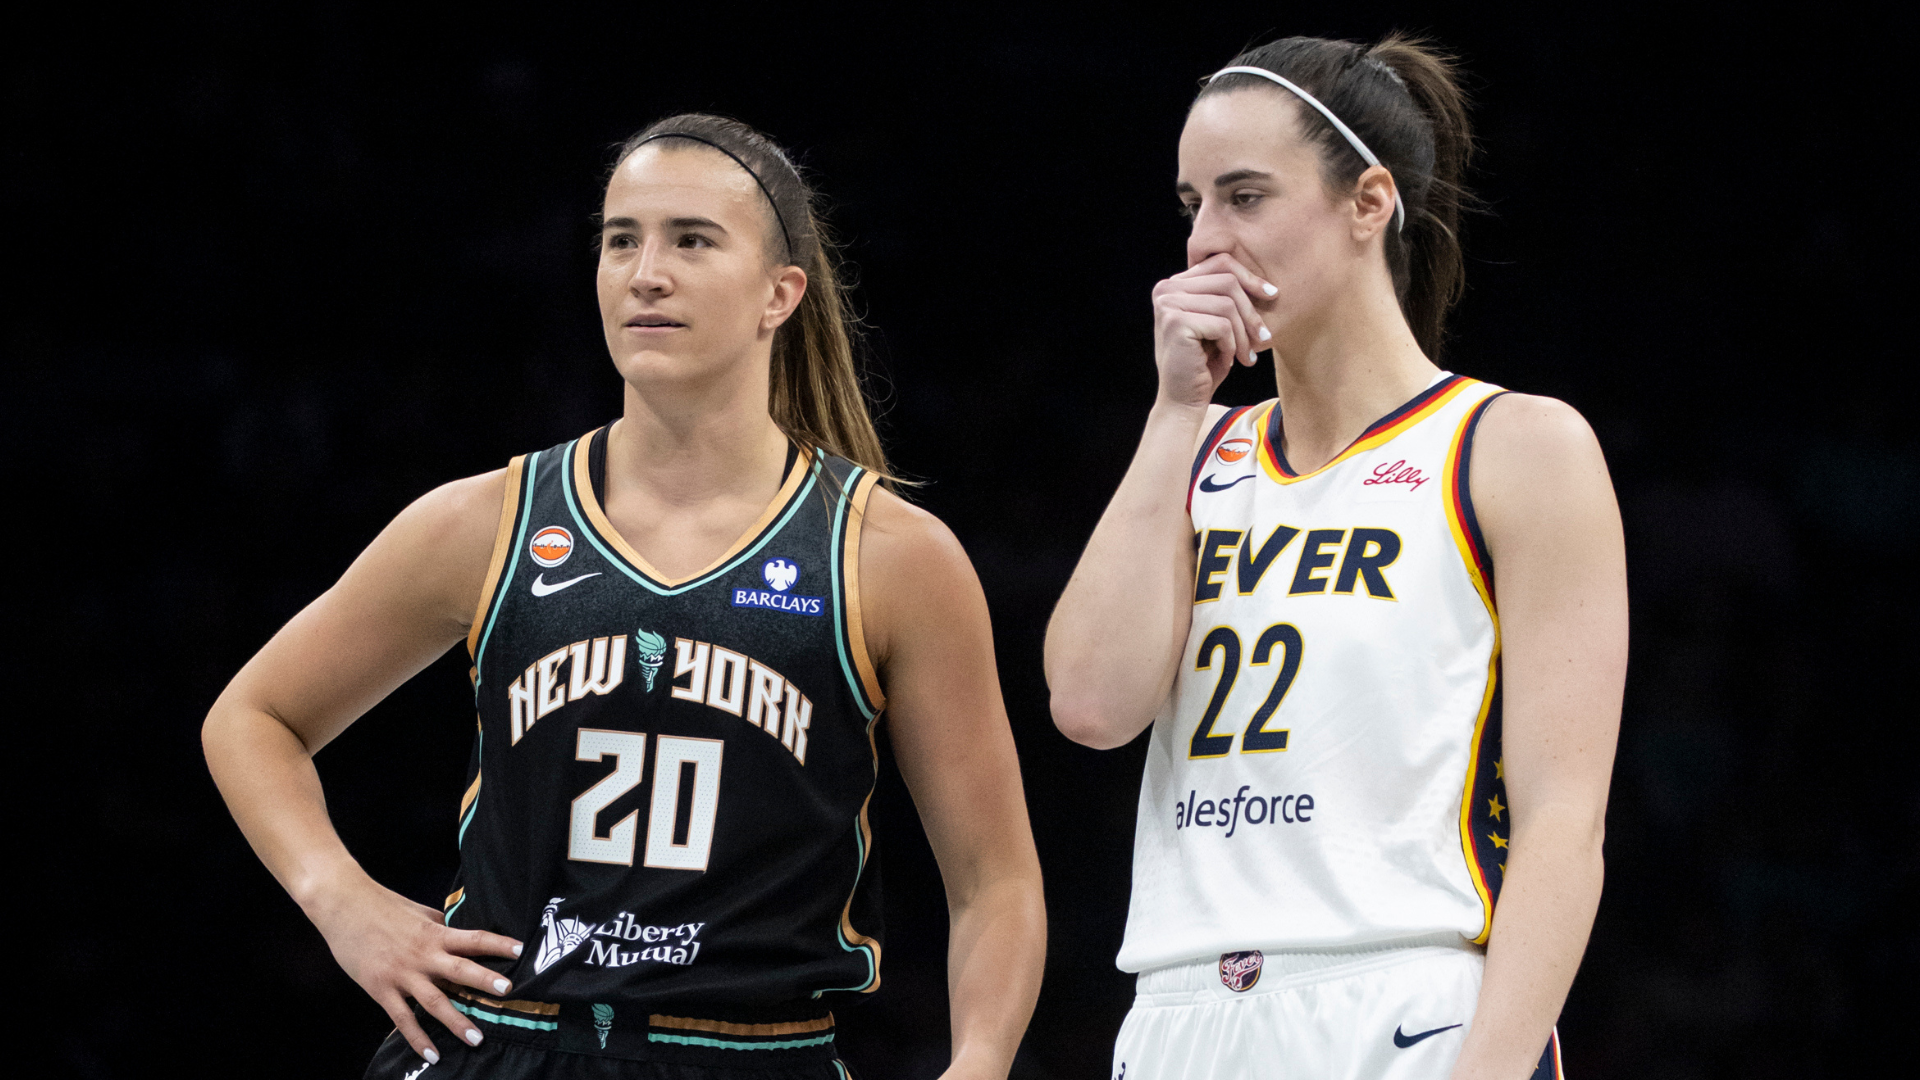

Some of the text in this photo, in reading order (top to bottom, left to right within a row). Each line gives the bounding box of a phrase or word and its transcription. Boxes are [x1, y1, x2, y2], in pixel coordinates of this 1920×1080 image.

[1363, 460, 1430, 491] Lilly
[1193, 524, 1402, 604] EVER
[735, 590, 821, 614] BARCLAYS
[508, 634, 813, 766] NEW YORK
[1188, 622, 1305, 760] 22
[568, 727, 724, 873] 20
[584, 939, 701, 968] Mutual
[594, 911, 705, 946] Liberty
